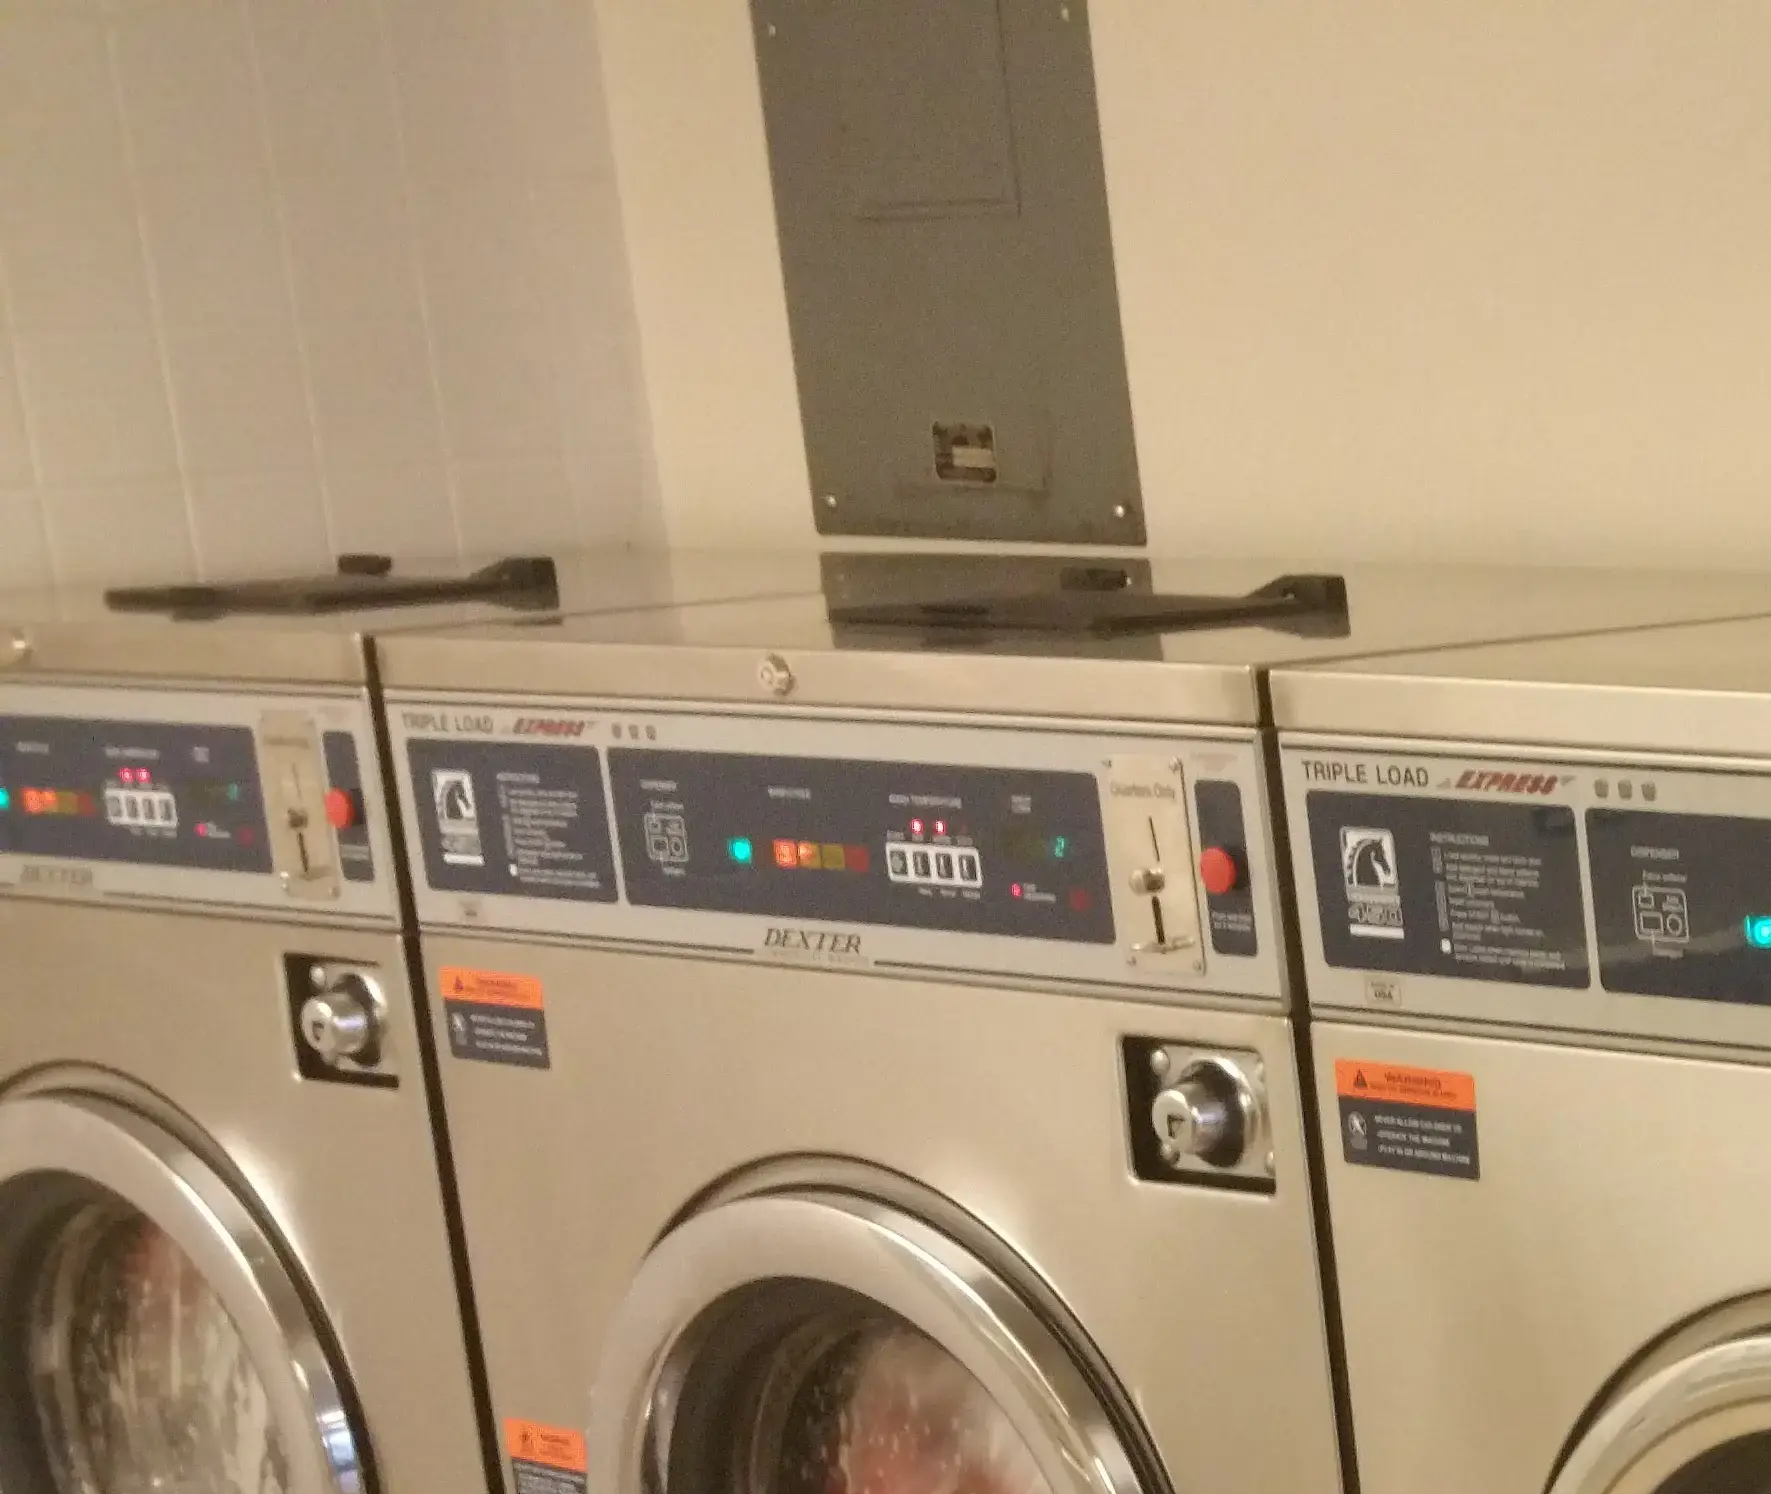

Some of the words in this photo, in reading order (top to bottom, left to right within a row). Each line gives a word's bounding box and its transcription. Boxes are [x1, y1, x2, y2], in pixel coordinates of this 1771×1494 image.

[1302, 759, 1367, 785] TRIPLE
[1376, 765, 1429, 788] LOAD
[1455, 769, 1559, 795] EXPRESS
[765, 928, 862, 955] DEXTER
